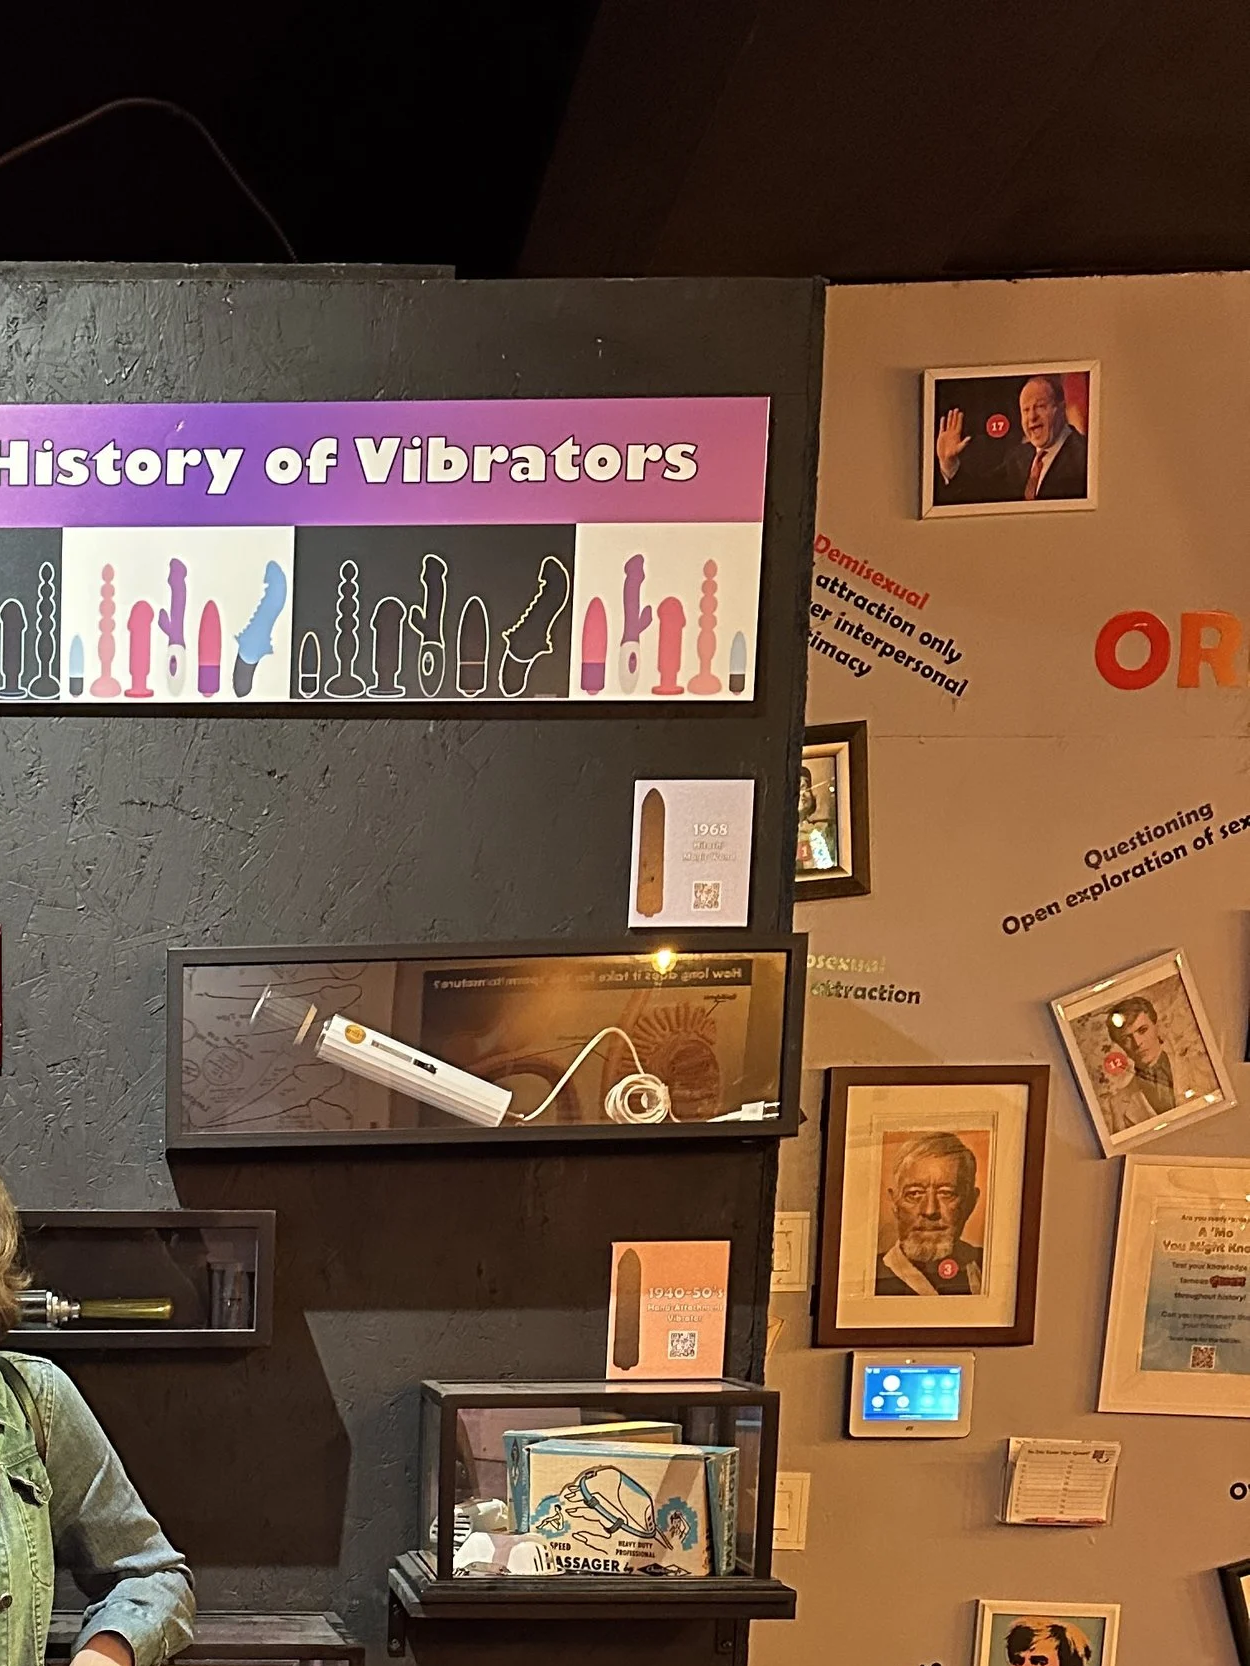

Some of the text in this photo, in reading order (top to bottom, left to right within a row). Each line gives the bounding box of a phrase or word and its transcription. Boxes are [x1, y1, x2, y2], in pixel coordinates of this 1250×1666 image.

[991, 421, 1005, 431] 17
[264, 436, 339, 486] of
[353, 434, 699, 484] Vibrators
[814, 533, 930, 610] Demisexual
[815, 574, 962, 665] attraction only
[810, 601, 969, 697] er interpersonal
[693, 823, 728, 836] 1968
[1084, 803, 1214, 870] Questioning
[1002, 901, 1062, 935] Open
[1065, 844, 1188, 908] exploration
[1192, 826, 1215, 851] of
[810, 979, 921, 1004] attraction
[1108, 1058, 1123, 1070] 12
[944, 1263, 952, 1275] 3
[549, 1541, 571, 1551] SPEED
[615, 1549, 656, 1559] PROFESSIONAL
[618, 1540, 654, 1549] HEAVY DUTY
[549, 1555, 621, 1572] ASSAGER
[623, 1562, 634, 1574] by
